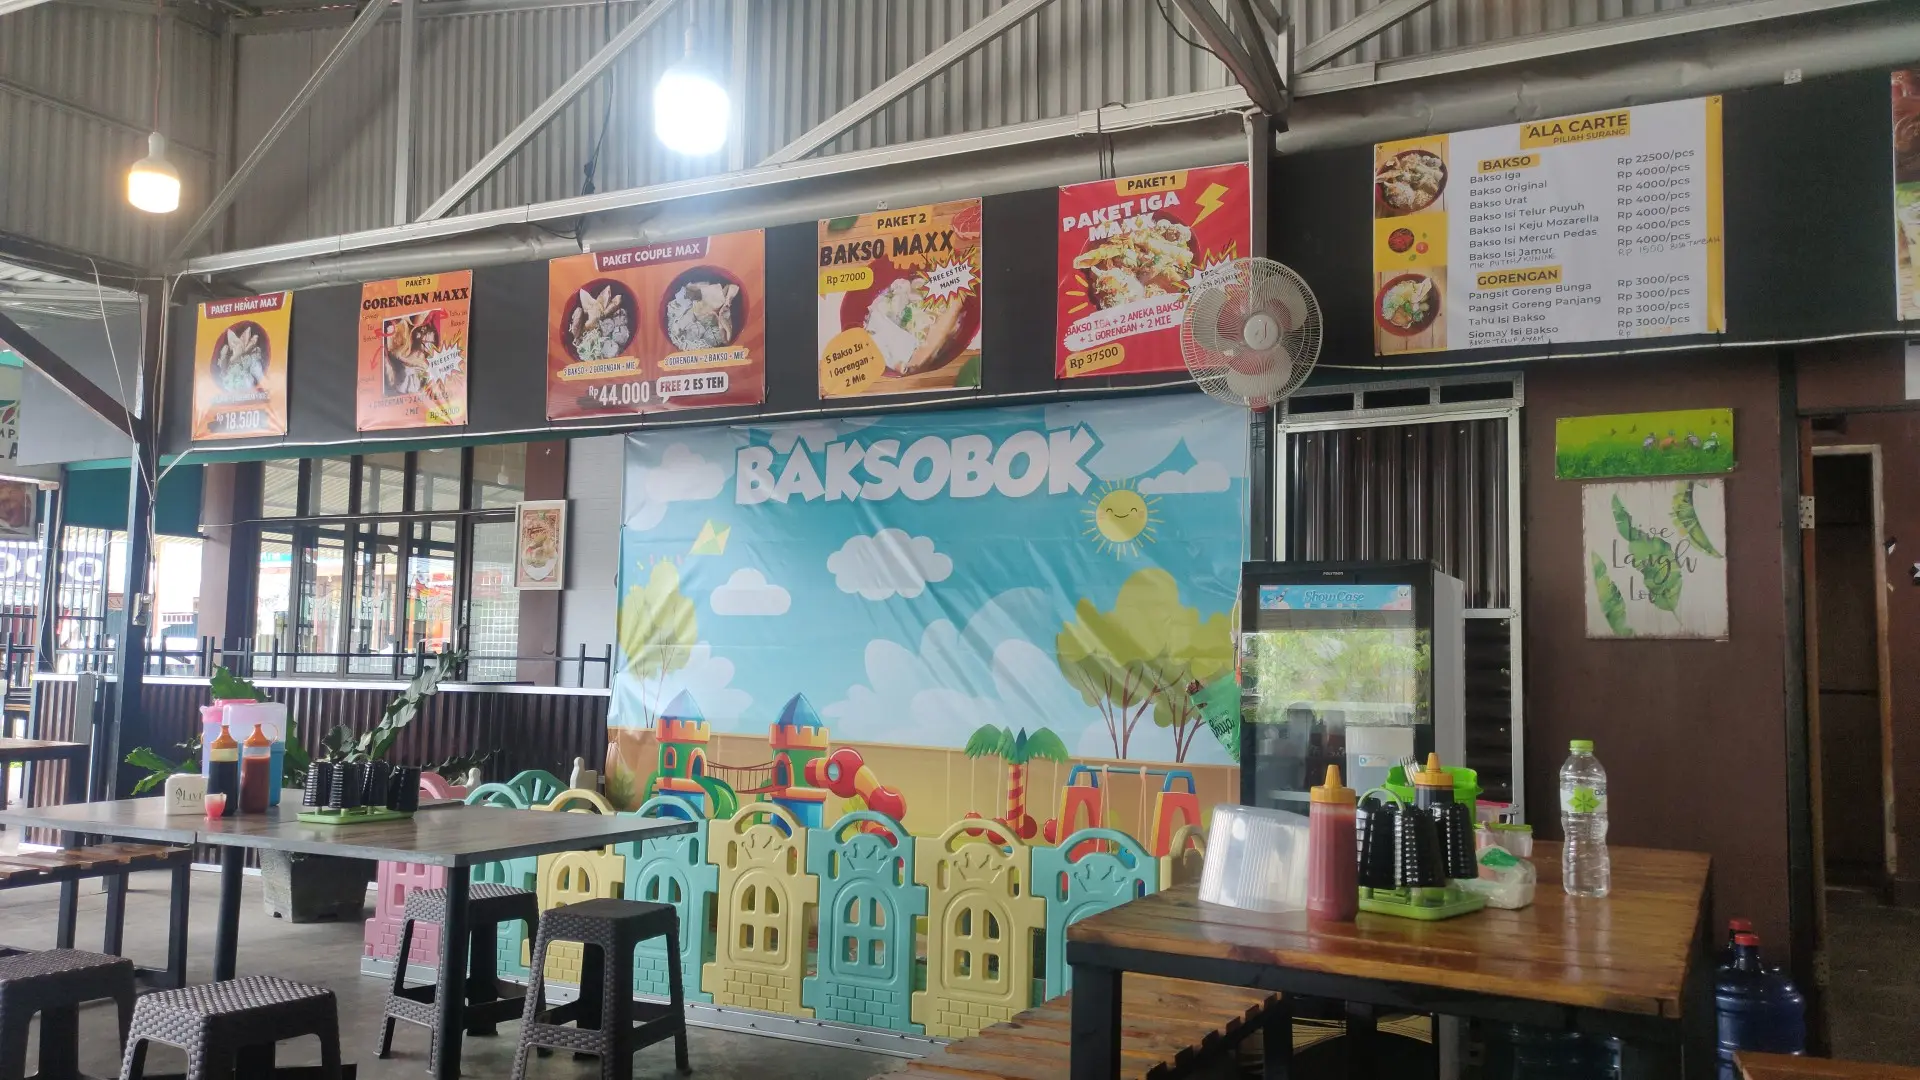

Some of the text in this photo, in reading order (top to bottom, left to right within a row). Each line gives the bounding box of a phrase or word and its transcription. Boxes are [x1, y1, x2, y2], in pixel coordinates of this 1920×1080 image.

[1529, 114, 1628, 138] ALA CARTE
[1586, 128, 1626, 140] SURANG
[1483, 156, 1531, 170] BAKSO
[1617, 150, 1694, 166] Rp 22500/pcs
[1470, 172, 1521, 184] Bakso Iga
[1617, 164, 1690, 180] Rp 4000/pcs
[1128, 176, 1176, 190] PAKET 1
[1470, 180, 1547, 197] Bakso Original
[1617, 178, 1690, 193] Rp 4000/pcs
[1470, 196, 1528, 210] Bakso Urat
[1617, 191, 1690, 206] Rp 4000/pcs
[1062, 191, 1180, 232] PAKET IGA
[1470, 203, 1584, 223] Bakso Isi Telur Puyuh
[1617, 205, 1690, 220] Rp 4000/pcs
[878, 213, 927, 230] PAKET 2
[1089, 212, 1155, 242] MAXX
[1470, 214, 1599, 236] Bakso Isi Keju Mozarella
[1617, 218, 1690, 234] Rp 4000/pcs
[1470, 228, 1597, 248] Bakso Isi Mercun Pedas
[1617, 232, 1690, 247] Rp 4000/pcs
[602, 244, 700, 267] PAKET COUPLE MAX
[820, 230, 954, 267] BAKSO MAXX
[1470, 248, 1553, 261] Bakso Isi Jamur
[826, 272, 866, 286] Rp 27000
[930, 272, 946, 284] FREE
[954, 264, 967, 273] TEH
[1477, 270, 1558, 286] GORENGAN
[1617, 274, 1690, 288] Rp 3000/pcs
[406, 278, 426, 288] PAKET
[940, 276, 960, 289] MANIS
[363, 288, 469, 310] GORENGAN MAXX
[1469, 284, 1592, 300] Pangsit Goreng Bunga
[1617, 288, 1690, 301] Rp 3000/pcs
[211, 298, 278, 314] PAKET HEMAT MAX
[1469, 296, 1602, 312] Pangsit Goreng Panjang
[1617, 301, 1690, 315] Rp 3000/pcs
[1066, 324, 1092, 336] BAKSO
[1094, 319, 1110, 330] IGA
[1120, 314, 1126, 323] 2
[1128, 310, 1154, 322] ANEKA
[1156, 300, 1184, 314] BAKSO
[1468, 314, 1546, 326] Tahu Isi Bakso
[1617, 315, 1690, 328] Rp 3000/pcs
[1096, 325, 1137, 340] GORENGAN
[1148, 320, 1153, 328] 2
[1155, 315, 1172, 326] MIE
[1468, 326, 1558, 338] Siomay Isi Bakso
[669, 356, 698, 366] GORENGAN
[709, 353, 728, 362] BAKSO
[734, 350, 744, 360] MIE
[826, 355, 832, 364] 5
[832, 348, 852, 362] Bakso
[854, 344, 864, 352] Isi
[1070, 346, 1118, 369] Rp 37500
[568, 368, 584, 376] BAKSO
[594, 364, 621, 375] GORENGAN
[626, 362, 636, 370] MIE
[834, 357, 868, 376] Gorengan
[660, 376, 724, 393] FREE 2 ES TEH
[846, 374, 866, 388] 2 Mie
[589, 382, 650, 406] Rp 44.000
[216, 410, 260, 430] Rp 18.500
[430, 412, 438, 420] Rp
[735, 425, 1096, 504] BAKSOBOK
[1612, 539, 1698, 586] Laugh
